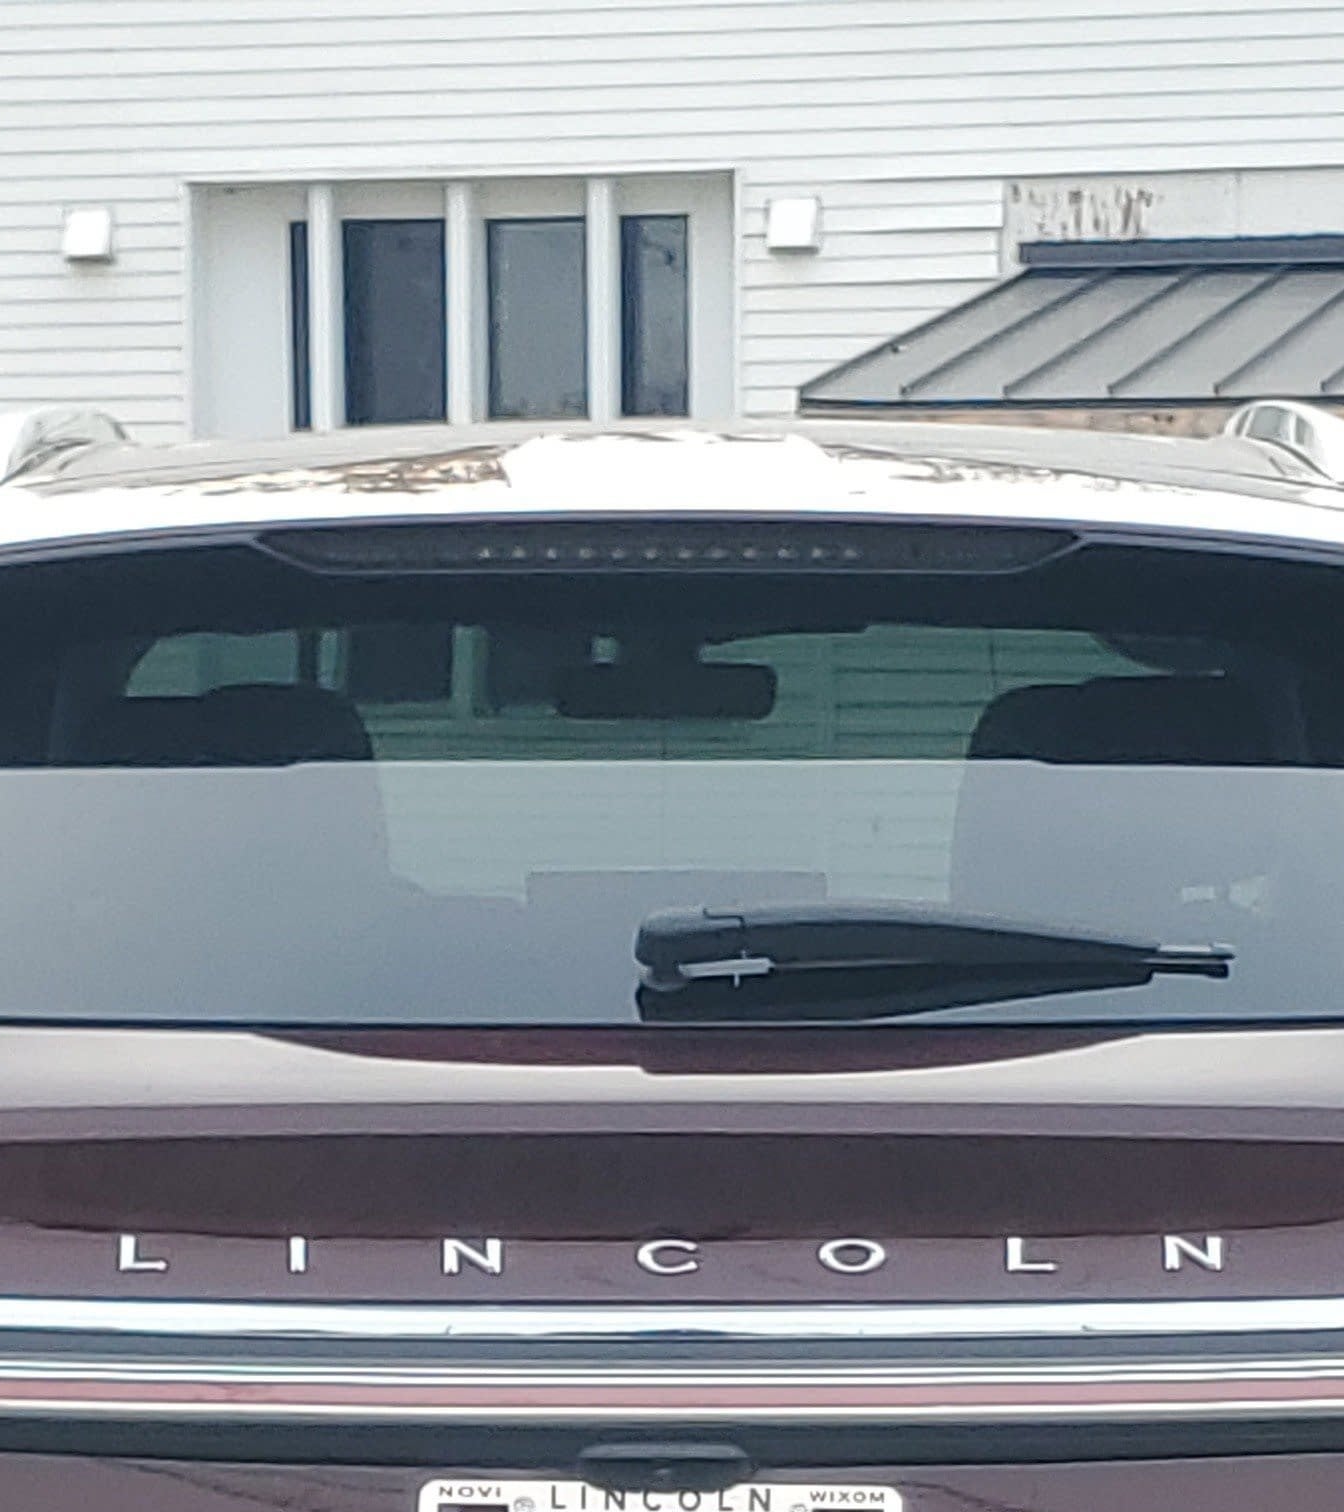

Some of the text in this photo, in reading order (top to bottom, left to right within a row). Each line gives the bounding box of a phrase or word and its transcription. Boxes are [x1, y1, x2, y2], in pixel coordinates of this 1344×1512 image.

[116, 1233, 1224, 1275] LINCOLN
[439, 1485, 501, 1498] NOVI
[551, 1485, 771, 1512] LINCOLN
[809, 1490, 886, 1503] WIXOM
